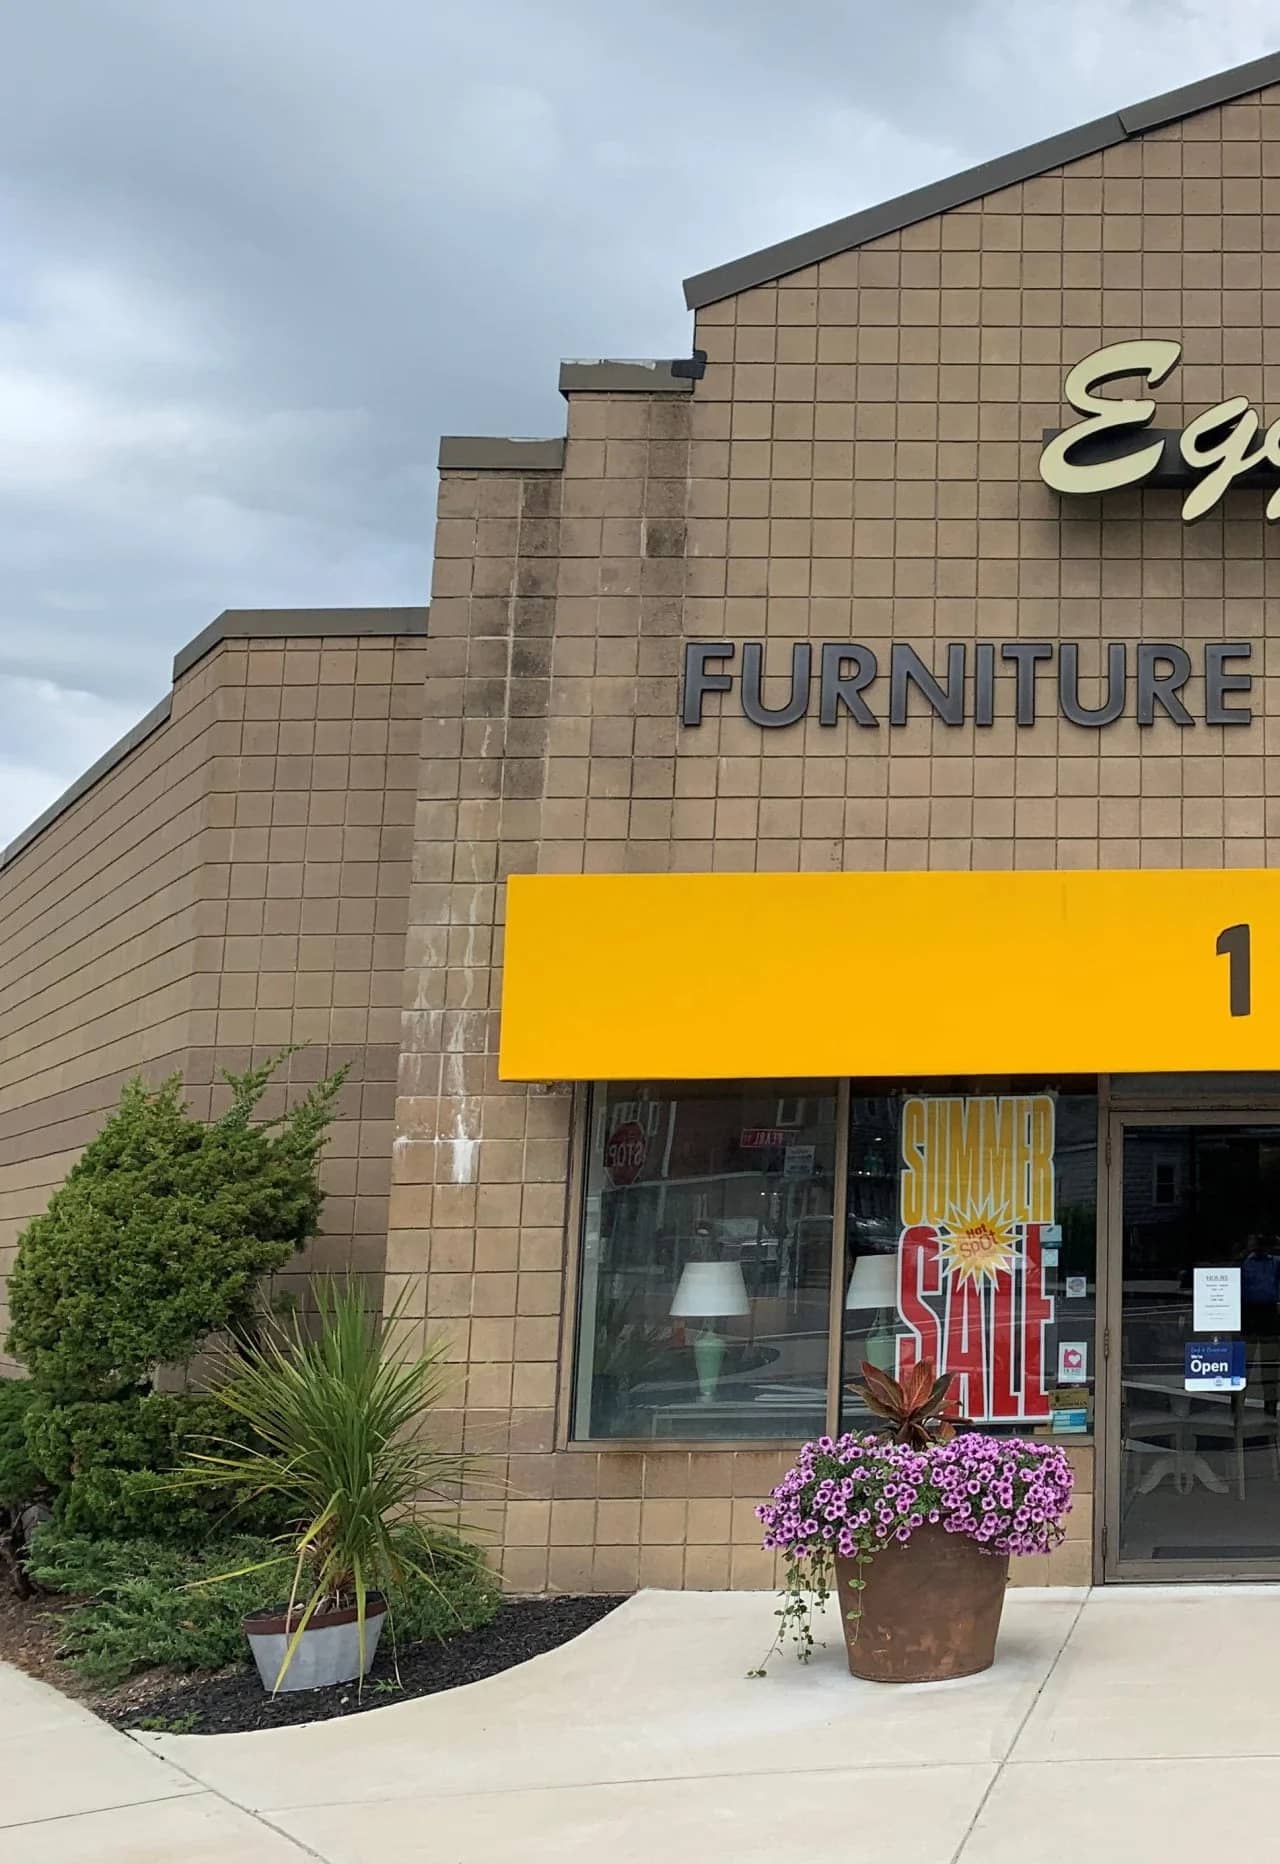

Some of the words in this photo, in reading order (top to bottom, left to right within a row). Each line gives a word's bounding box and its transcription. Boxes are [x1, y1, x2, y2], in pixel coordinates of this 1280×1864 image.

[682, 642, 1252, 728] FURNITURE
[901, 1095, 1055, 1226] SUMMER
[966, 1223, 988, 1239] Hot
[895, 1223, 1055, 1421] SALE
[1190, 1359, 1229, 1376] Open
